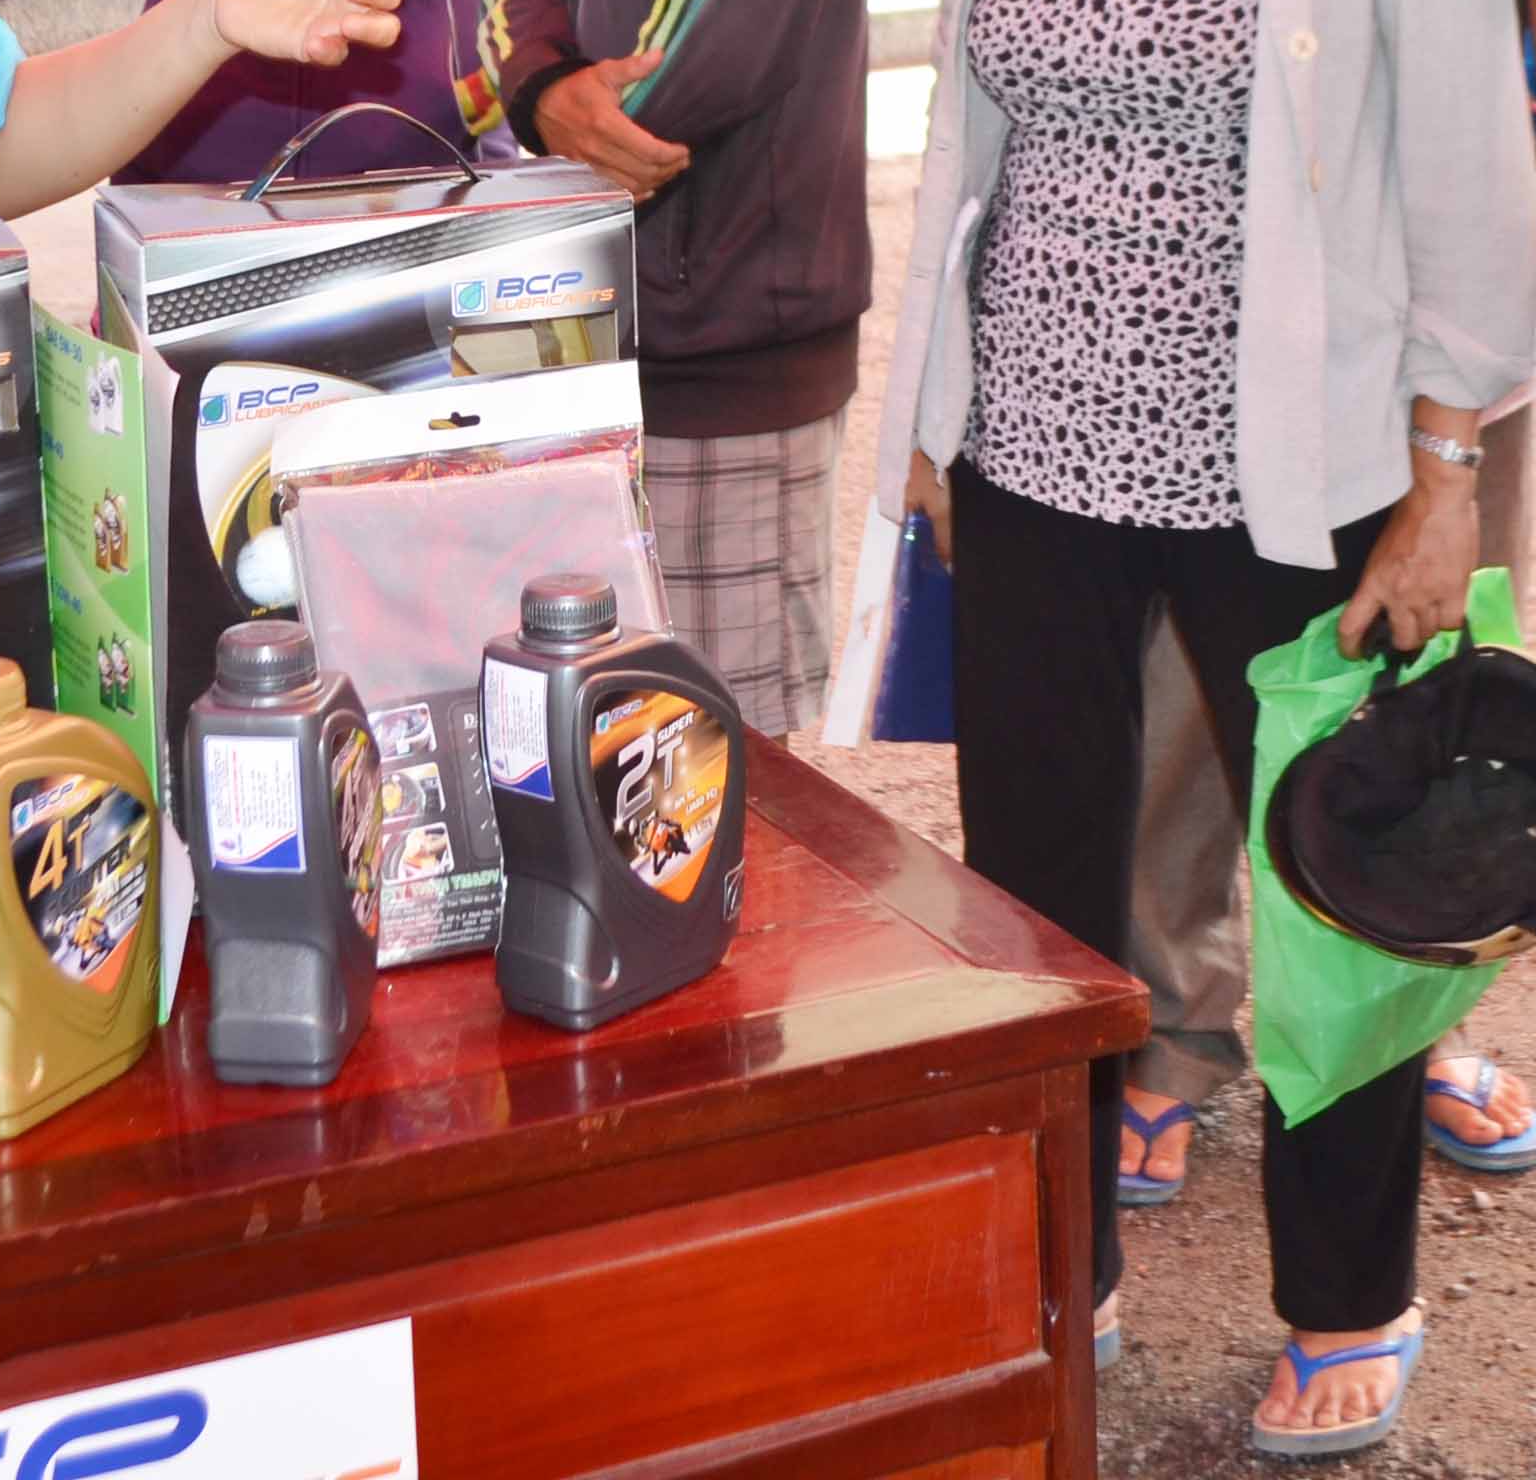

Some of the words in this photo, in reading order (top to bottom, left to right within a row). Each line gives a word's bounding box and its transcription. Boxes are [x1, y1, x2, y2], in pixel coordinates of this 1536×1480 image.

[495, 270, 585, 299] BCP
[236, 381, 320, 410] BCP
[655, 710, 695, 743] SUPER
[616, 731, 683, 824] 2T
[28, 818, 92, 900] 4T
